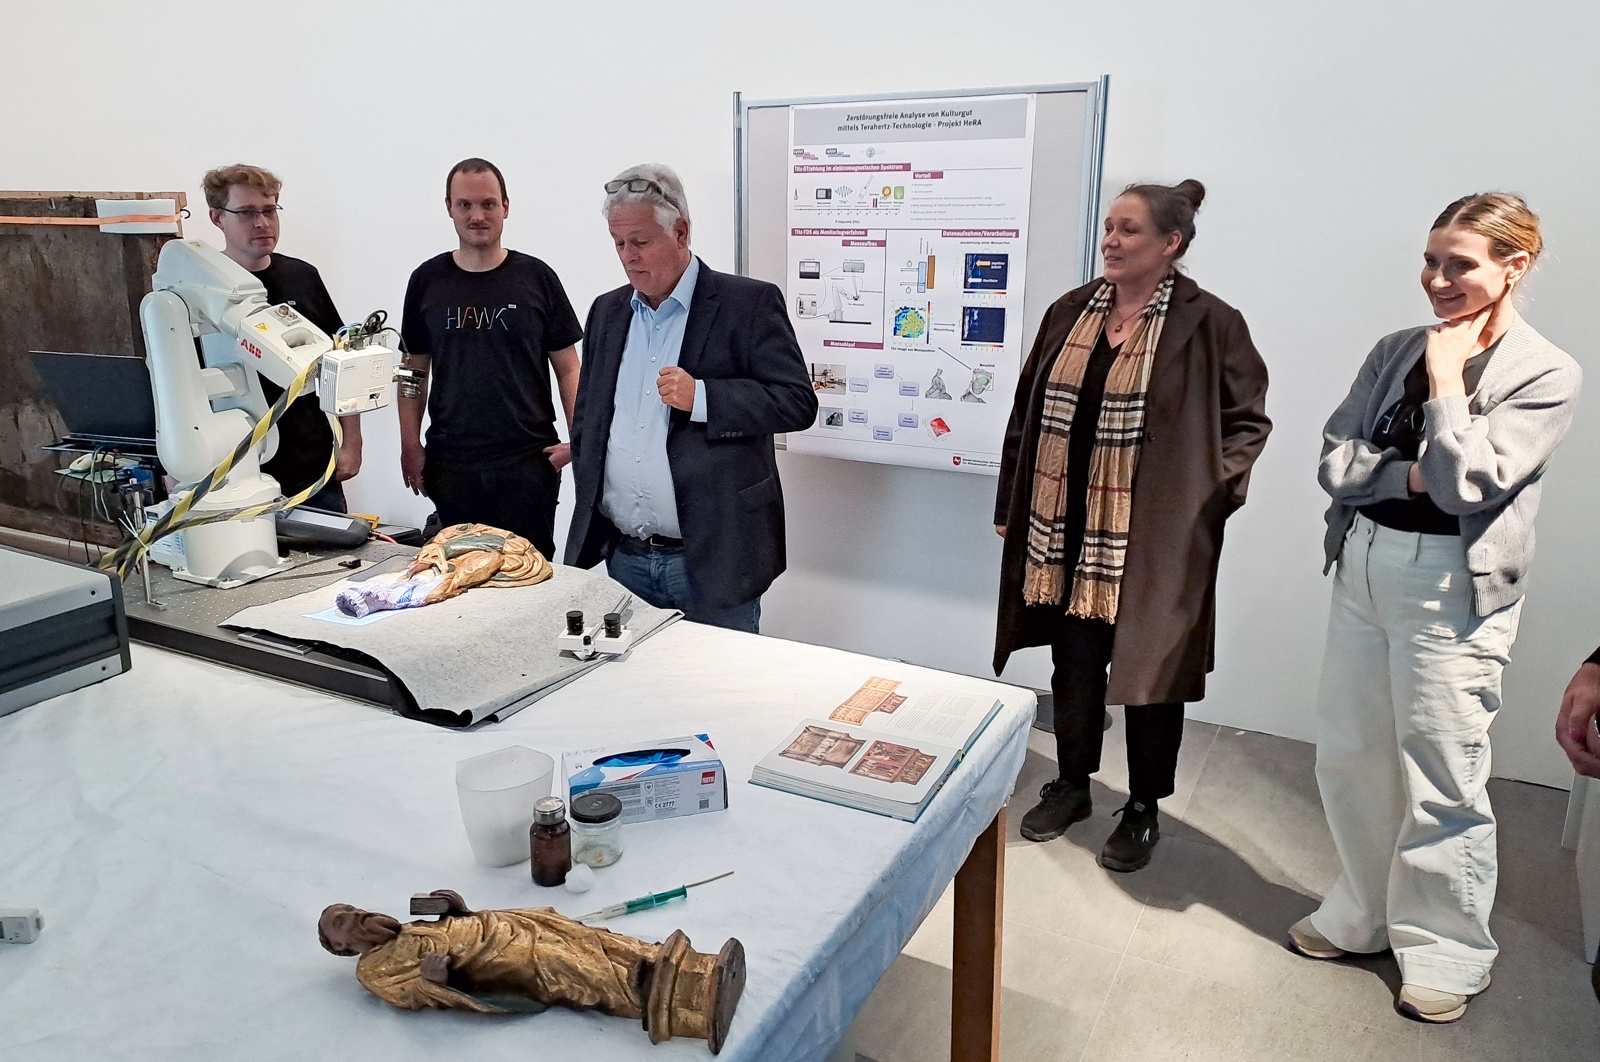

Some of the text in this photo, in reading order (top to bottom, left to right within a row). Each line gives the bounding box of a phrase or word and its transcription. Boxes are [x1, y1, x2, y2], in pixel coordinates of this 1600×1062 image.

[846, 112, 899, 122] Zerstörungsfreie
[900, 111, 926, 120] Analyse
[941, 109, 973, 118] Kulturgut
[837, 123, 859, 132] mittels
[860, 120, 932, 131] Terahertz-Technologie
[937, 120, 962, 129] Projekt
[963, 119, 982, 127] HeRA
[880, 163, 904, 171] Spektrum
[942, 230, 1017, 238] Datenaufnahme/Verarbeitung
[445, 306, 509, 331] HAWK
[240, 338, 262, 359] ABB
[830, 340, 856, 348] Messablauf
